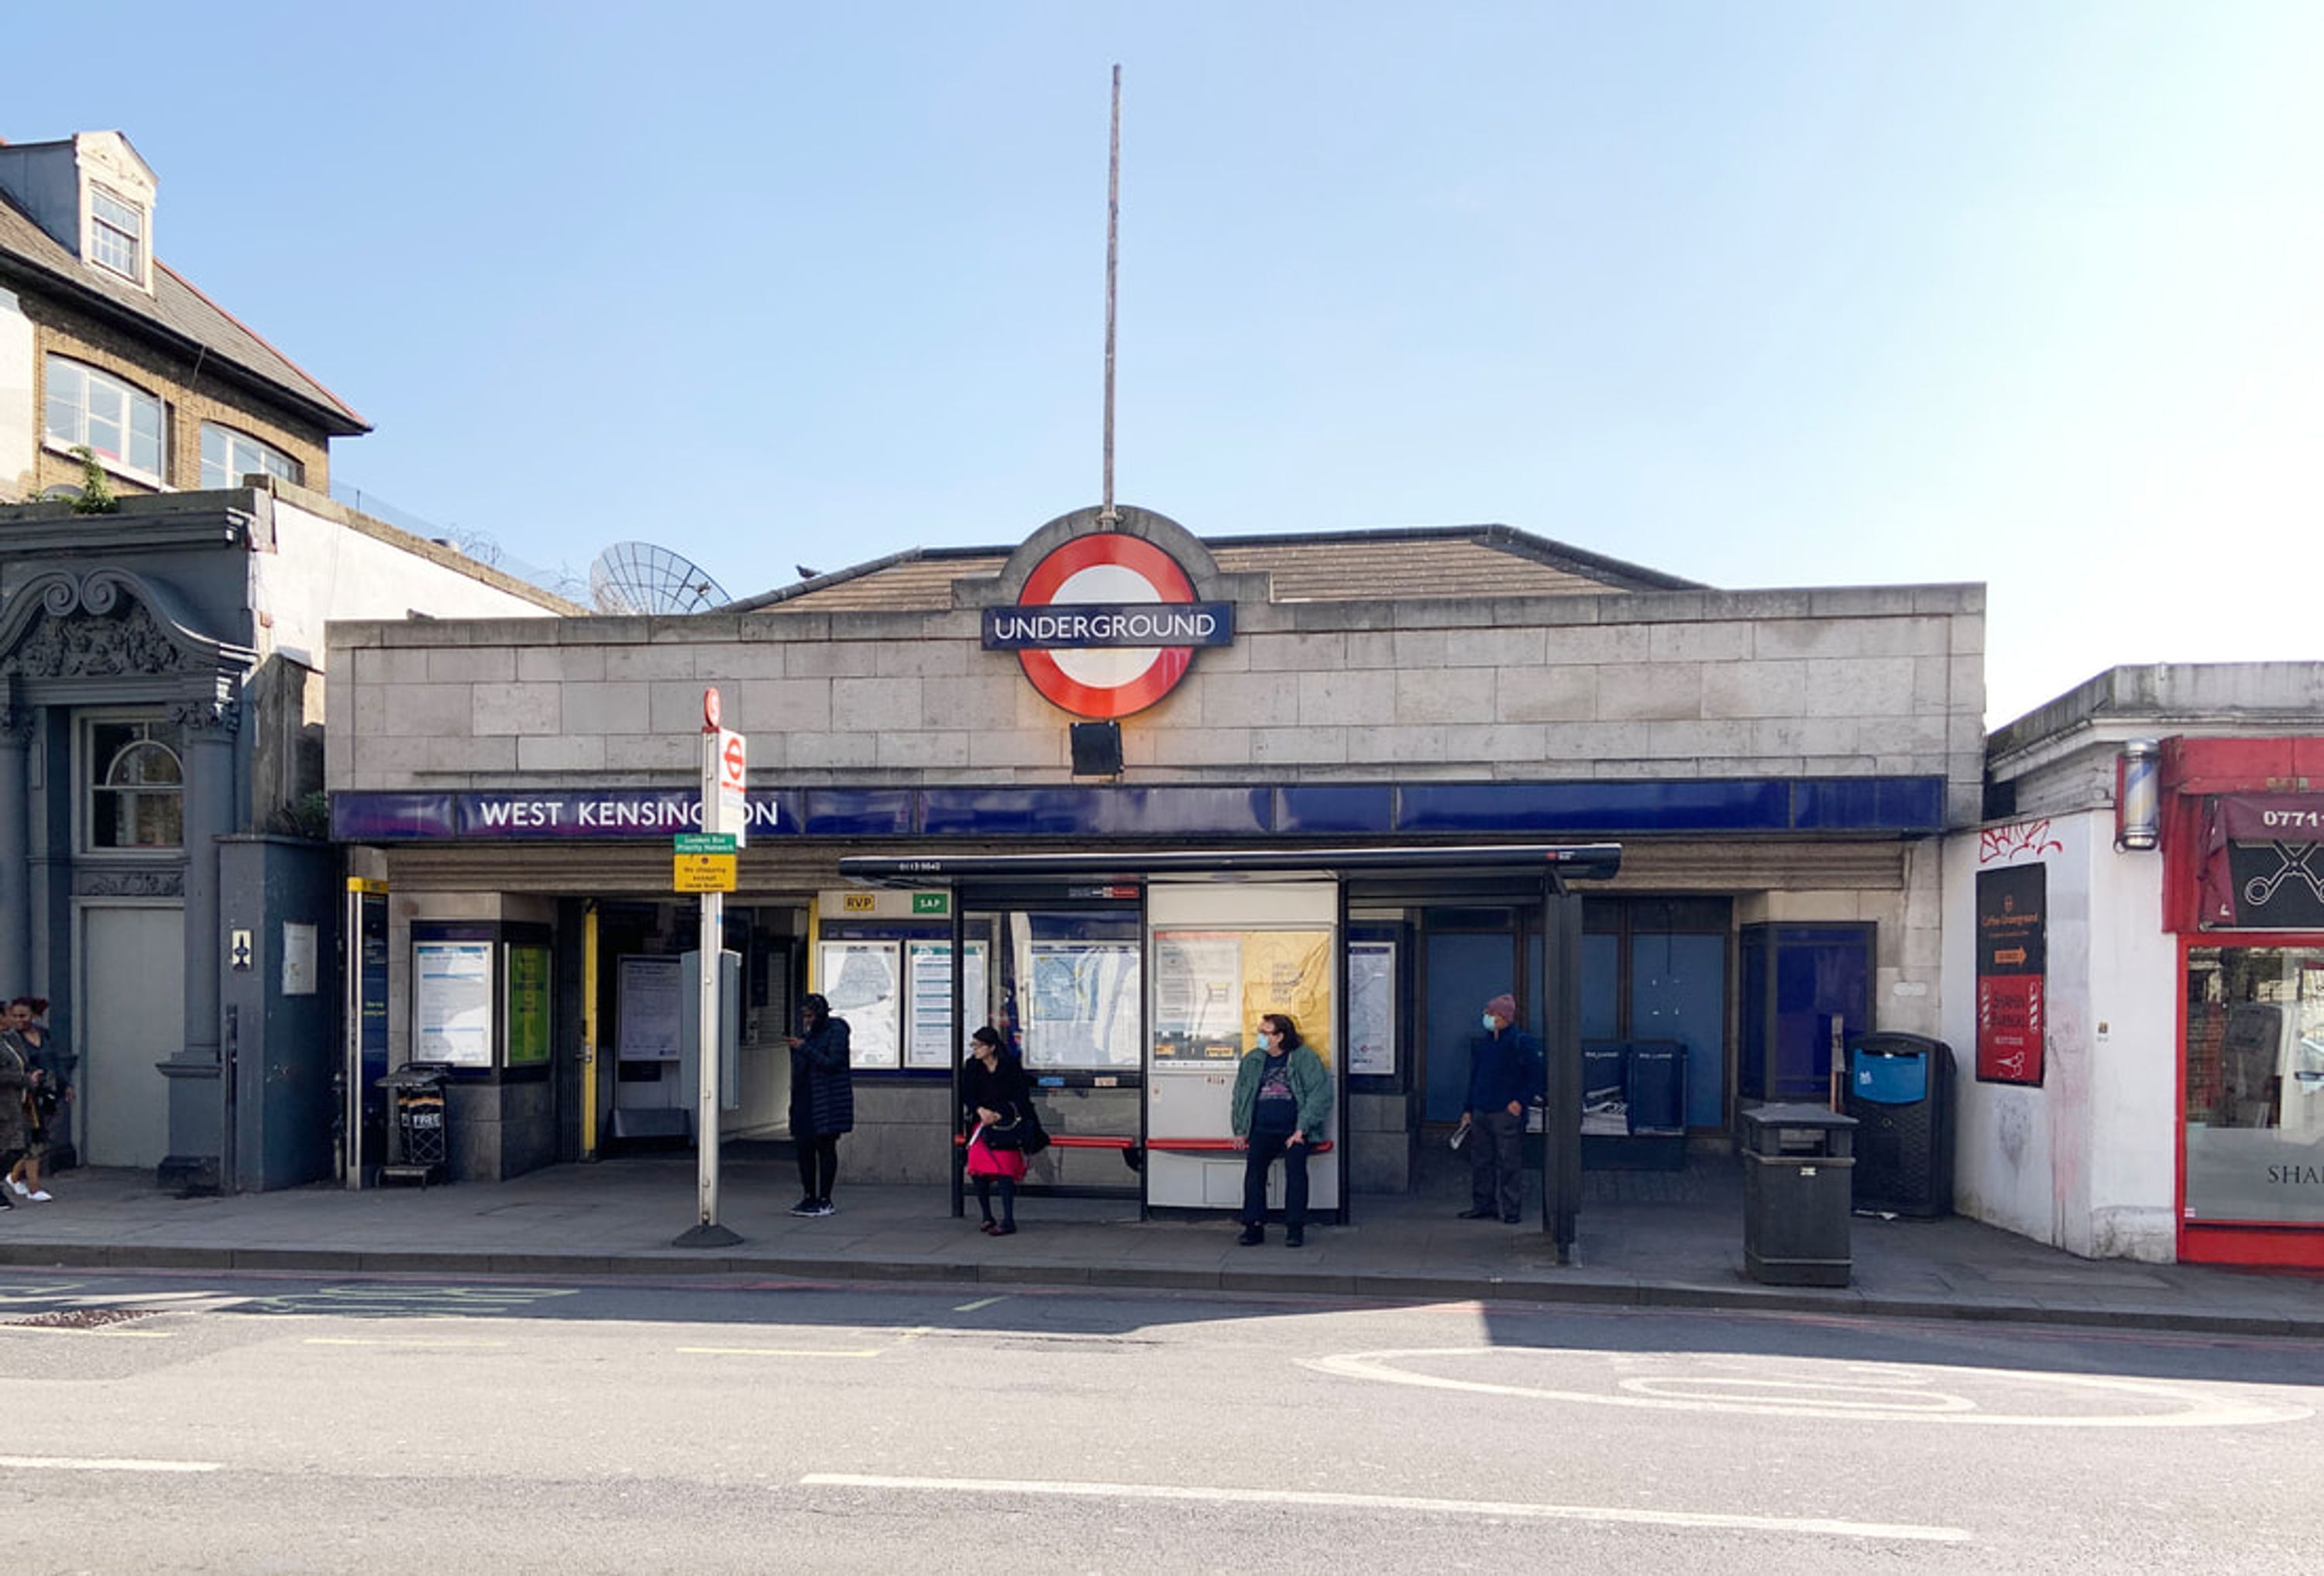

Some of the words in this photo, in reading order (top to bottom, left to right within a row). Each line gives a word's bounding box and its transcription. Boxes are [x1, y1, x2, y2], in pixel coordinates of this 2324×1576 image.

[995, 614, 1215, 639] UNDERGROUND
[480, 802, 563, 825] WEST
[579, 802, 778, 825] KENSINN
[2264, 811, 2324, 827] 0771
[847, 897, 872, 908] RVP
[920, 898, 940, 908] SAP
[2267, 1165, 2324, 1184] SHA
